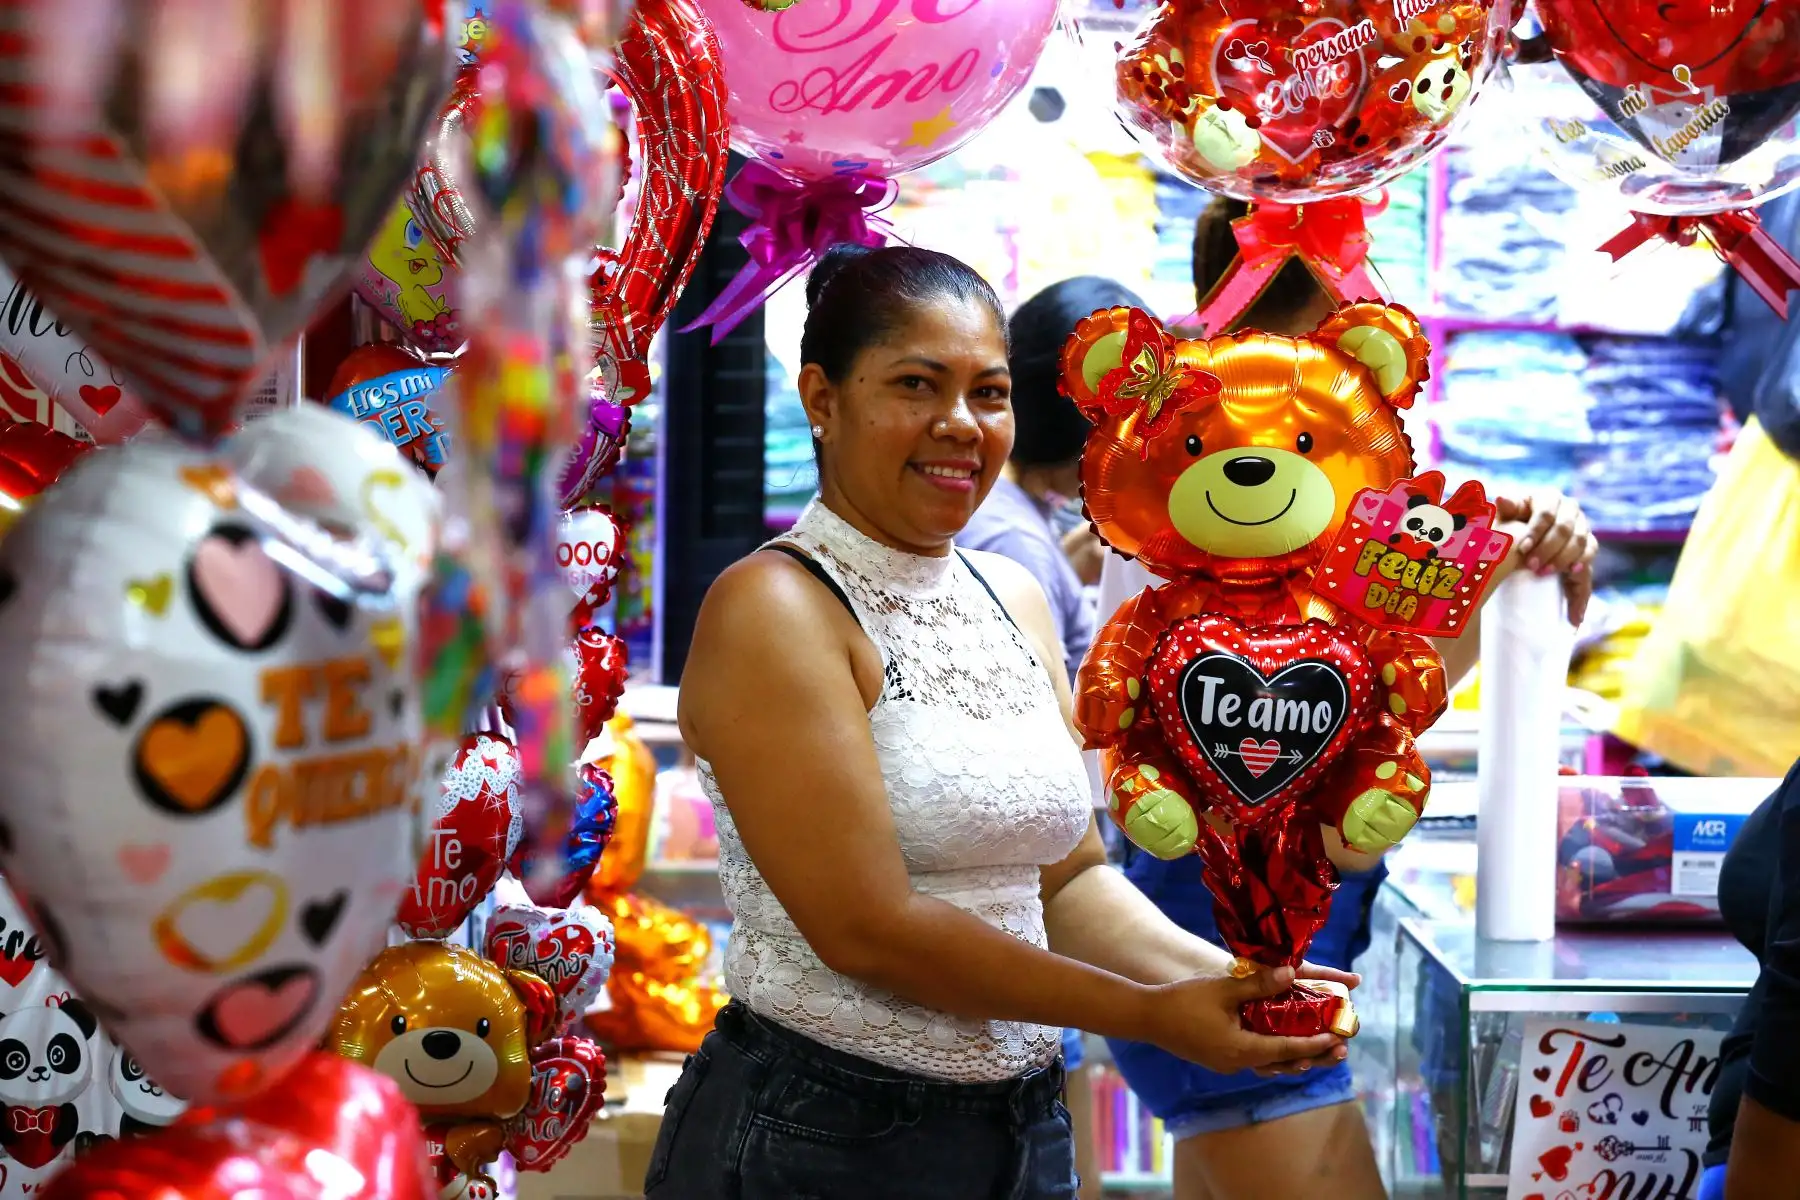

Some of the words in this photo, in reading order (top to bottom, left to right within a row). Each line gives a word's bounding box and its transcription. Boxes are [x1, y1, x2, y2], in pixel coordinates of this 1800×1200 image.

[769, 33, 980, 116] Amo
[1294, 22, 1374, 82] persona
[1619, 85, 1648, 118] mi
[1653, 99, 1729, 164] favorita
[347, 381, 400, 420] Eres
[401, 372, 433, 397] mi
[260, 655, 373, 749] TE
[1197, 675, 1242, 729] Te
[1248, 697, 1332, 734] amo
[430, 828, 462, 870] Te
[1538, 1028, 1626, 1098] Te
